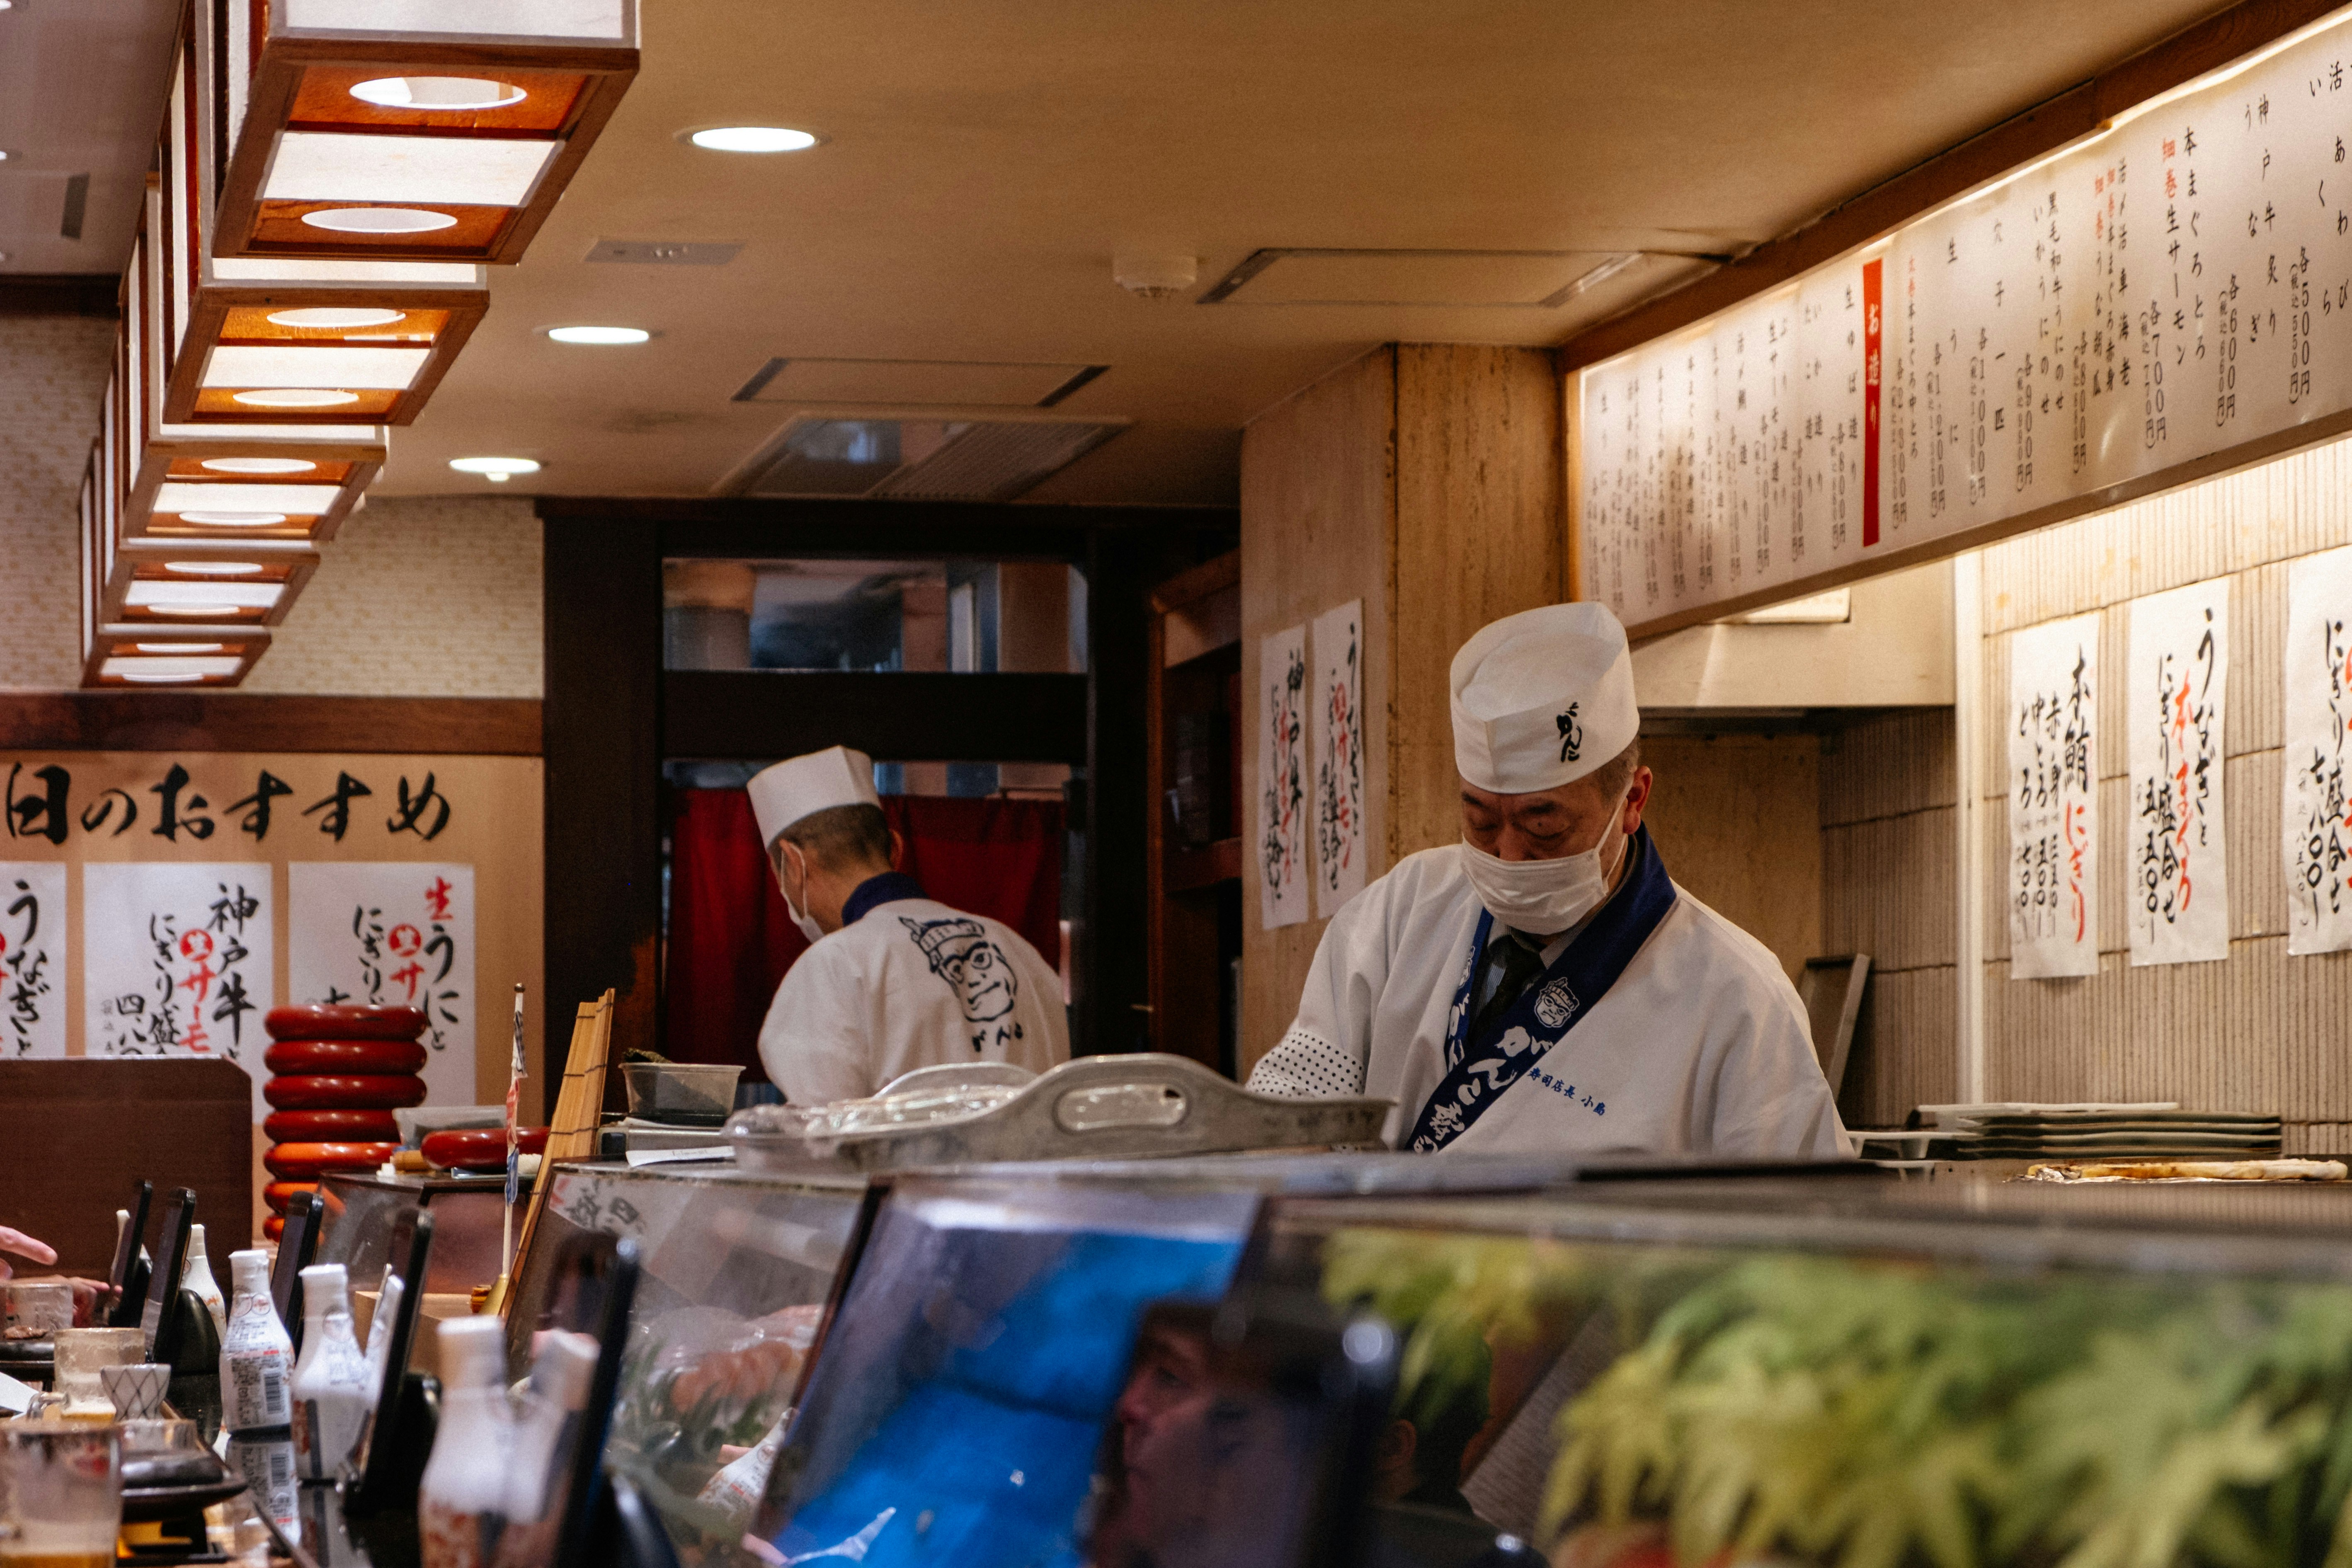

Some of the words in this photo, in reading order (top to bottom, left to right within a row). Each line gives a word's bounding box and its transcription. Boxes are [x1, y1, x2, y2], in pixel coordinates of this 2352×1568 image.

[2184, 127, 2206, 359] 本まぐろとろ
[2245, 104, 2260, 344] うなぎ
[2309, 78, 2331, 316] いくら
[2330, 61, 2350, 309] 活あわび
[6, 761, 451, 846] 日のおすすめ
[2194, 607, 2216, 846] うなぎと
